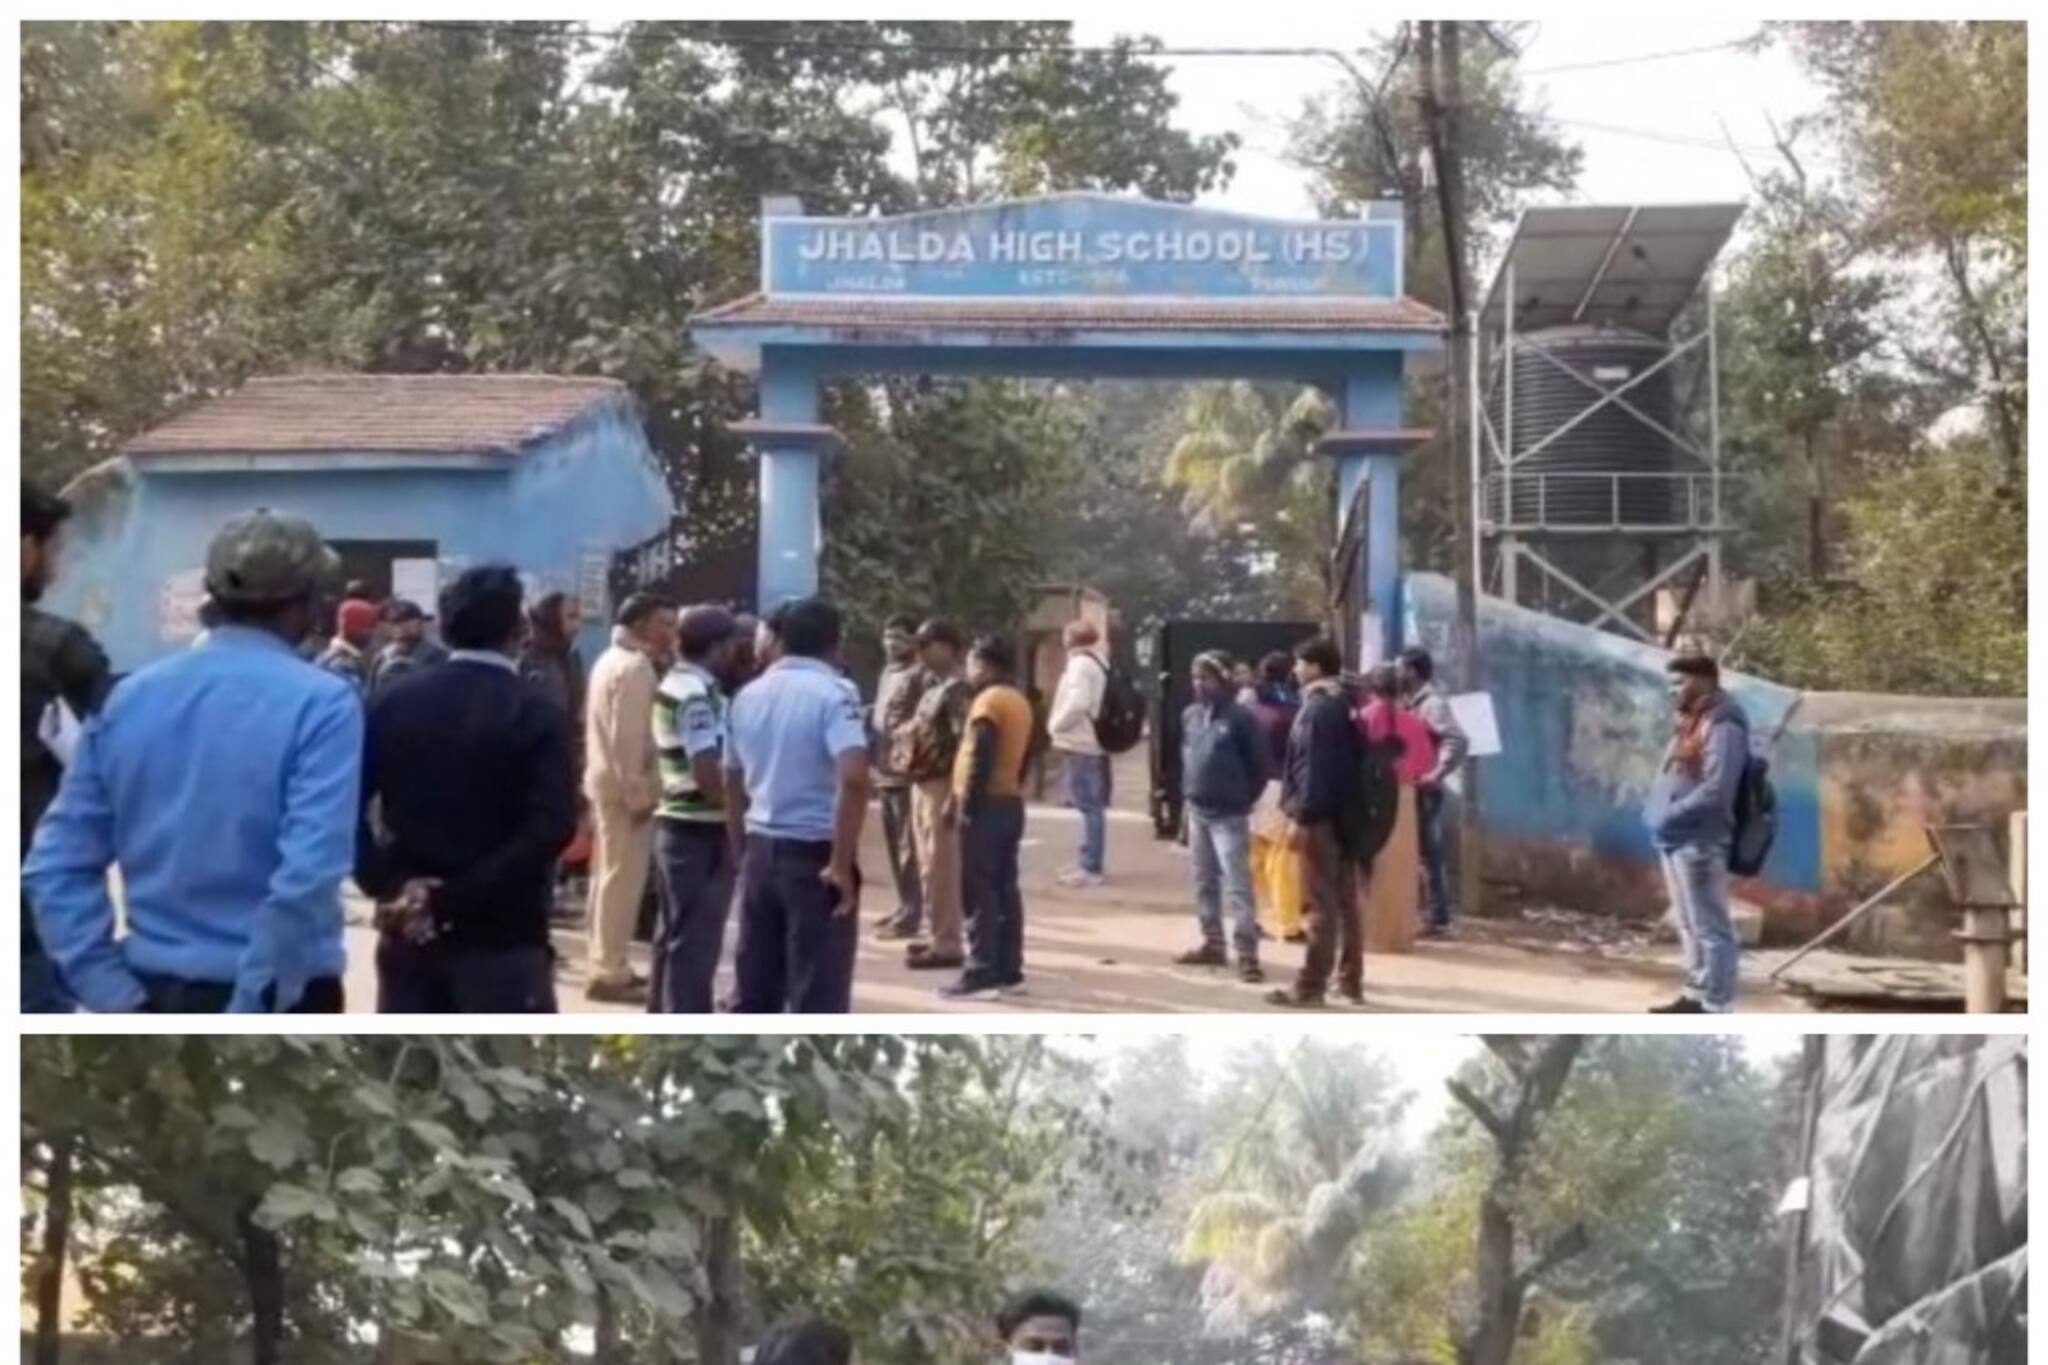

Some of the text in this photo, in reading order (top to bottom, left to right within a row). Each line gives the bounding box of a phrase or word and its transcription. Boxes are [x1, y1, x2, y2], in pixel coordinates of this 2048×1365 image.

[800, 229, 1370, 268] JHALDA HIGH SCHOOL (HS)
